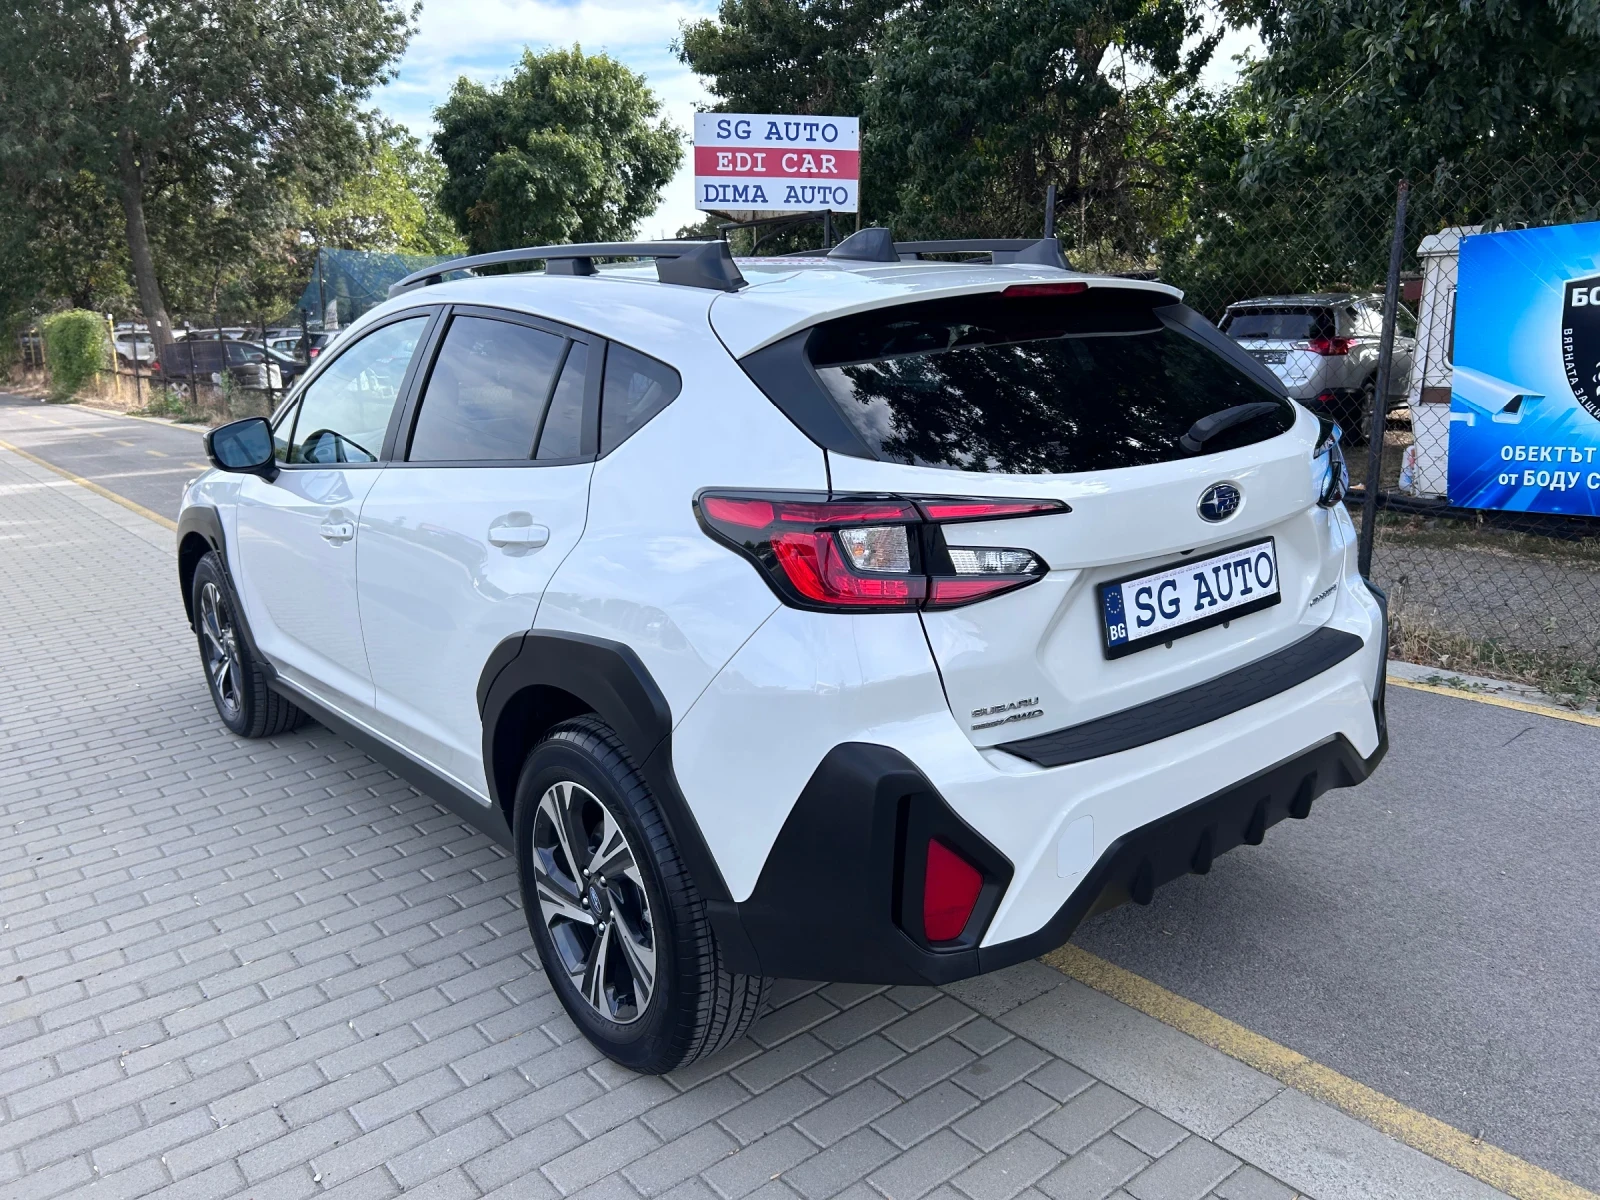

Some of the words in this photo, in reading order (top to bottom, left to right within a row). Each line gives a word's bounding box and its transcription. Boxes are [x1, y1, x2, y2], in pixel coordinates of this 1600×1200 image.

[716, 119, 752, 140] SG
[764, 121, 838, 143] AUTO
[716, 152, 767, 172] EDI
[781, 153, 838, 174] CAR
[703, 184, 768, 203] DIMA
[783, 185, 848, 205] AUTO
[1563, 328, 1579, 385] ВЯРНАТА
[1501, 445, 1597, 463] ОБЕКТЪТ
[1498, 473, 1519, 486] от
[1523, 470, 1581, 491] БОДУ
[1135, 579, 1181, 629] SG
[1193, 551, 1274, 611] AUTO
[1110, 623, 1127, 641] BG
[971, 697, 1039, 718] SUBARU
